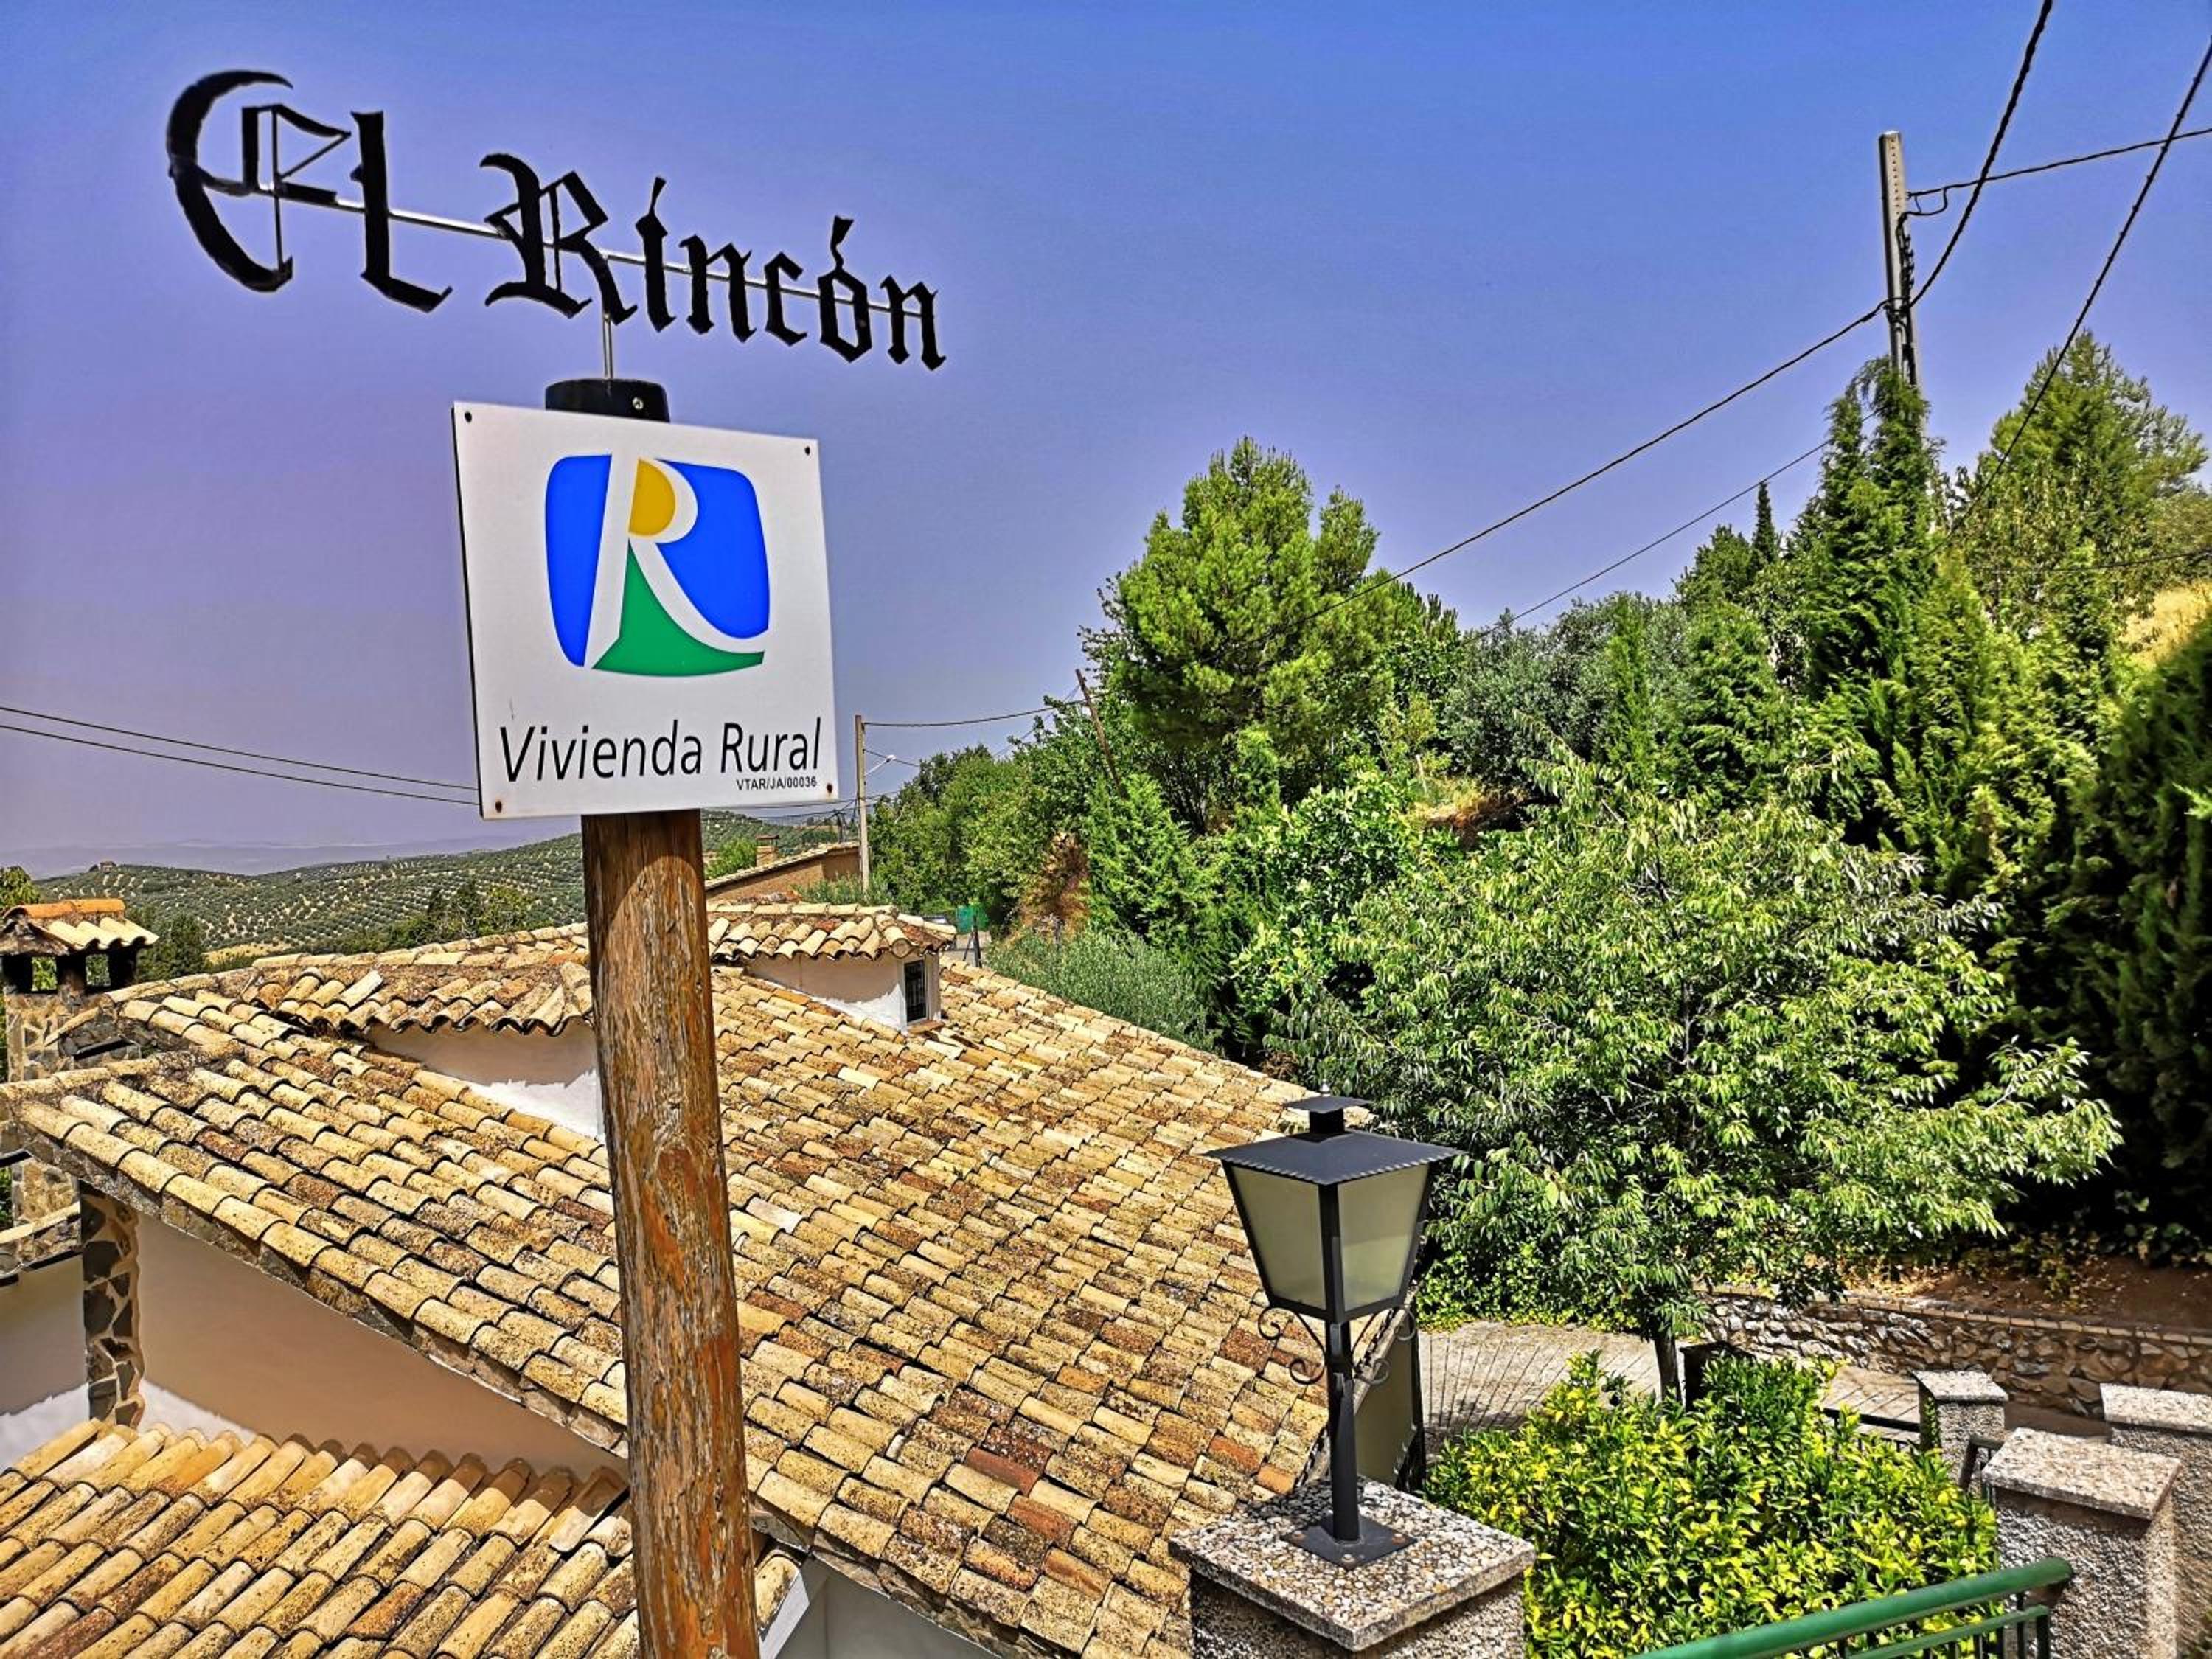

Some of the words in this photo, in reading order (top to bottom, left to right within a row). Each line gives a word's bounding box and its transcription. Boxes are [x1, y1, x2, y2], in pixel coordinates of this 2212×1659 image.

[165, 69, 453, 313] El
[499, 719, 703, 782] Vivienda
[720, 717, 821, 774] Rural
[736, 776, 818, 792] VTAR/JA/00036
